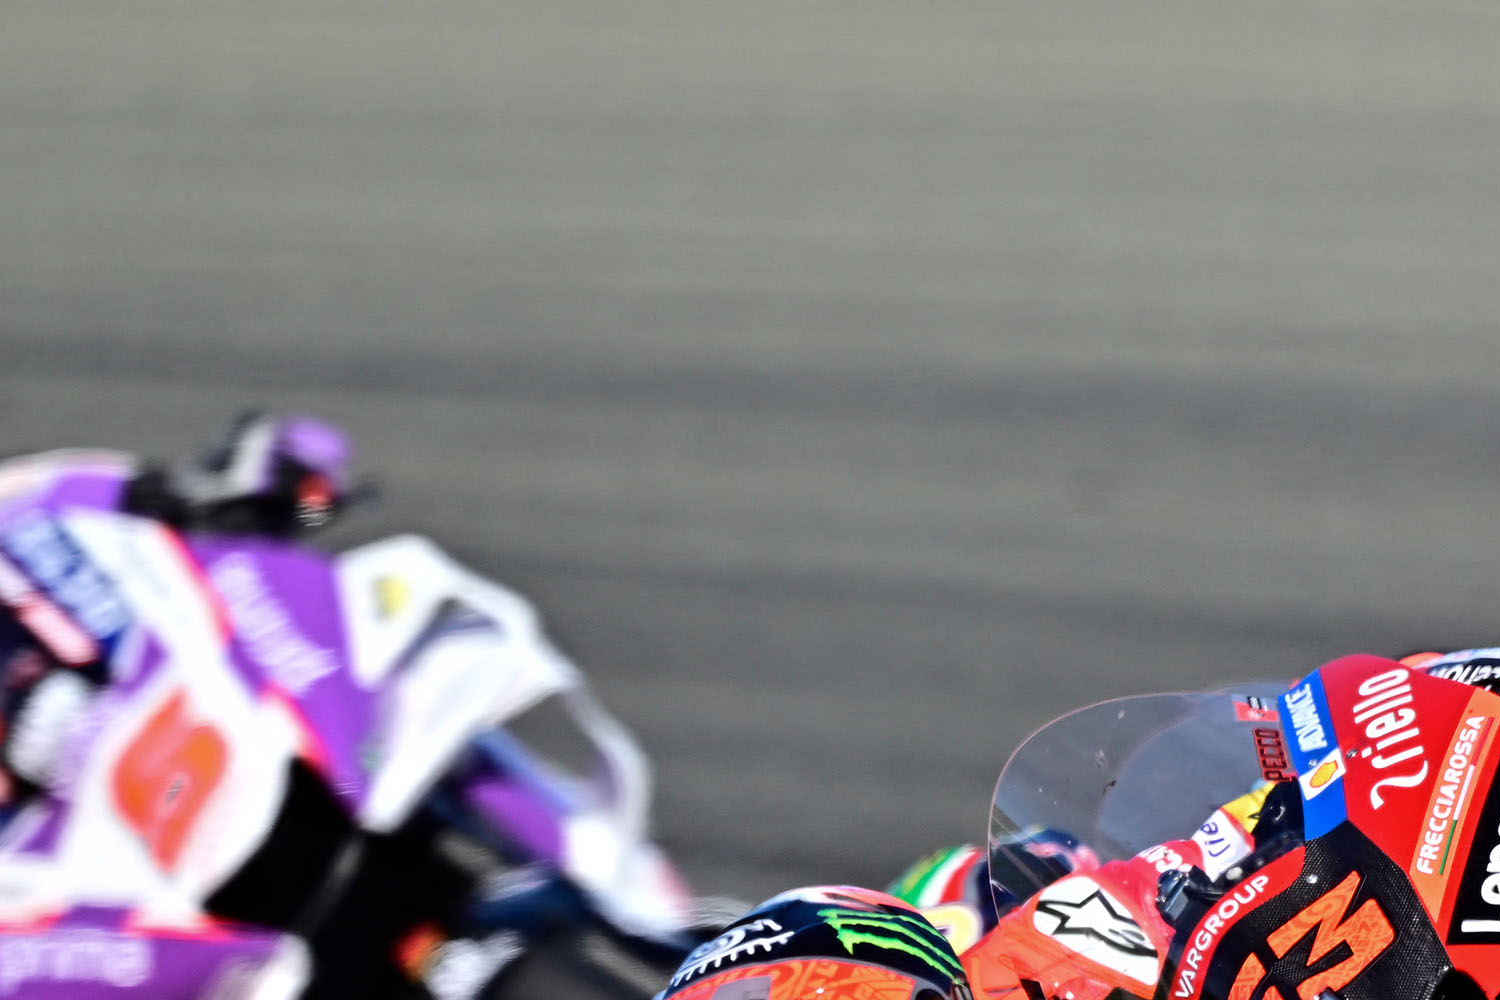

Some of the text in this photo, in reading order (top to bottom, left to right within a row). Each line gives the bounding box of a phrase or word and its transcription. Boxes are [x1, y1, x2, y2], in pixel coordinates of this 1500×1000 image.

[1284, 683, 1328, 752] ADVANCE
[1415, 714, 1486, 875] FRECCIAROSSA
[1174, 874, 1270, 999] VARGROUP
